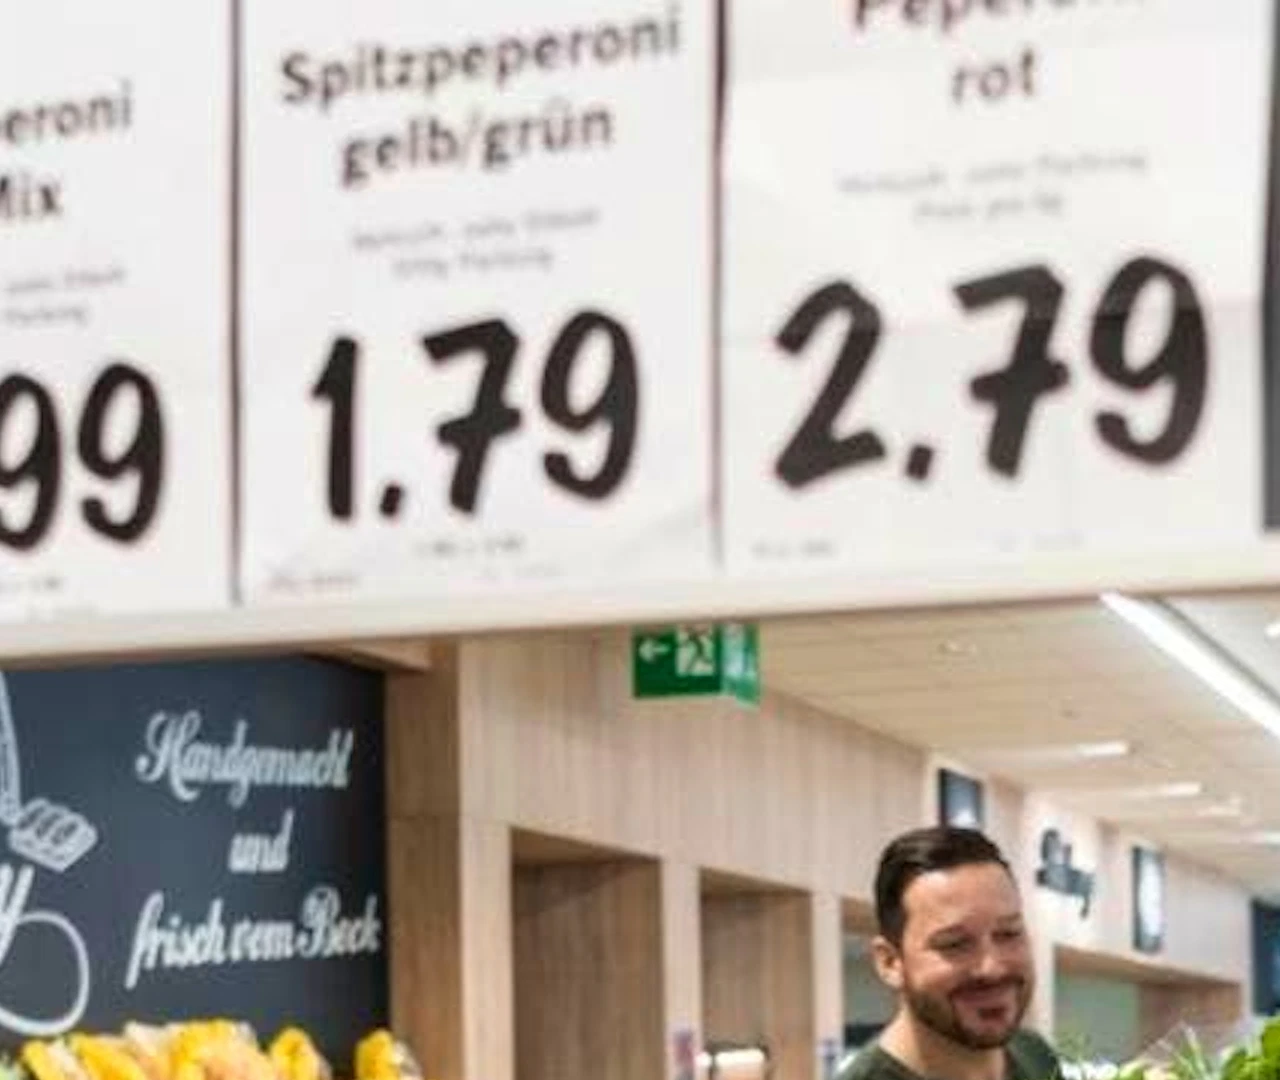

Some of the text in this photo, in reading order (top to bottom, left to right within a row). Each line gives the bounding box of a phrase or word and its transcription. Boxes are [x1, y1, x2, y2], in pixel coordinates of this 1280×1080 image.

[280, 3, 681, 113] Spitzpeperoni
[950, 46, 1036, 102] rot
[340, 99, 613, 190] gelb/grün
[310, 309, 640, 523] 1.79
[773, 255, 1212, 491] 2.79
[134, 710, 355, 810] Handgemacht
[226, 808, 295, 875] und
[123, 889, 228, 990] frisch
[295, 883, 382, 960] Beck
